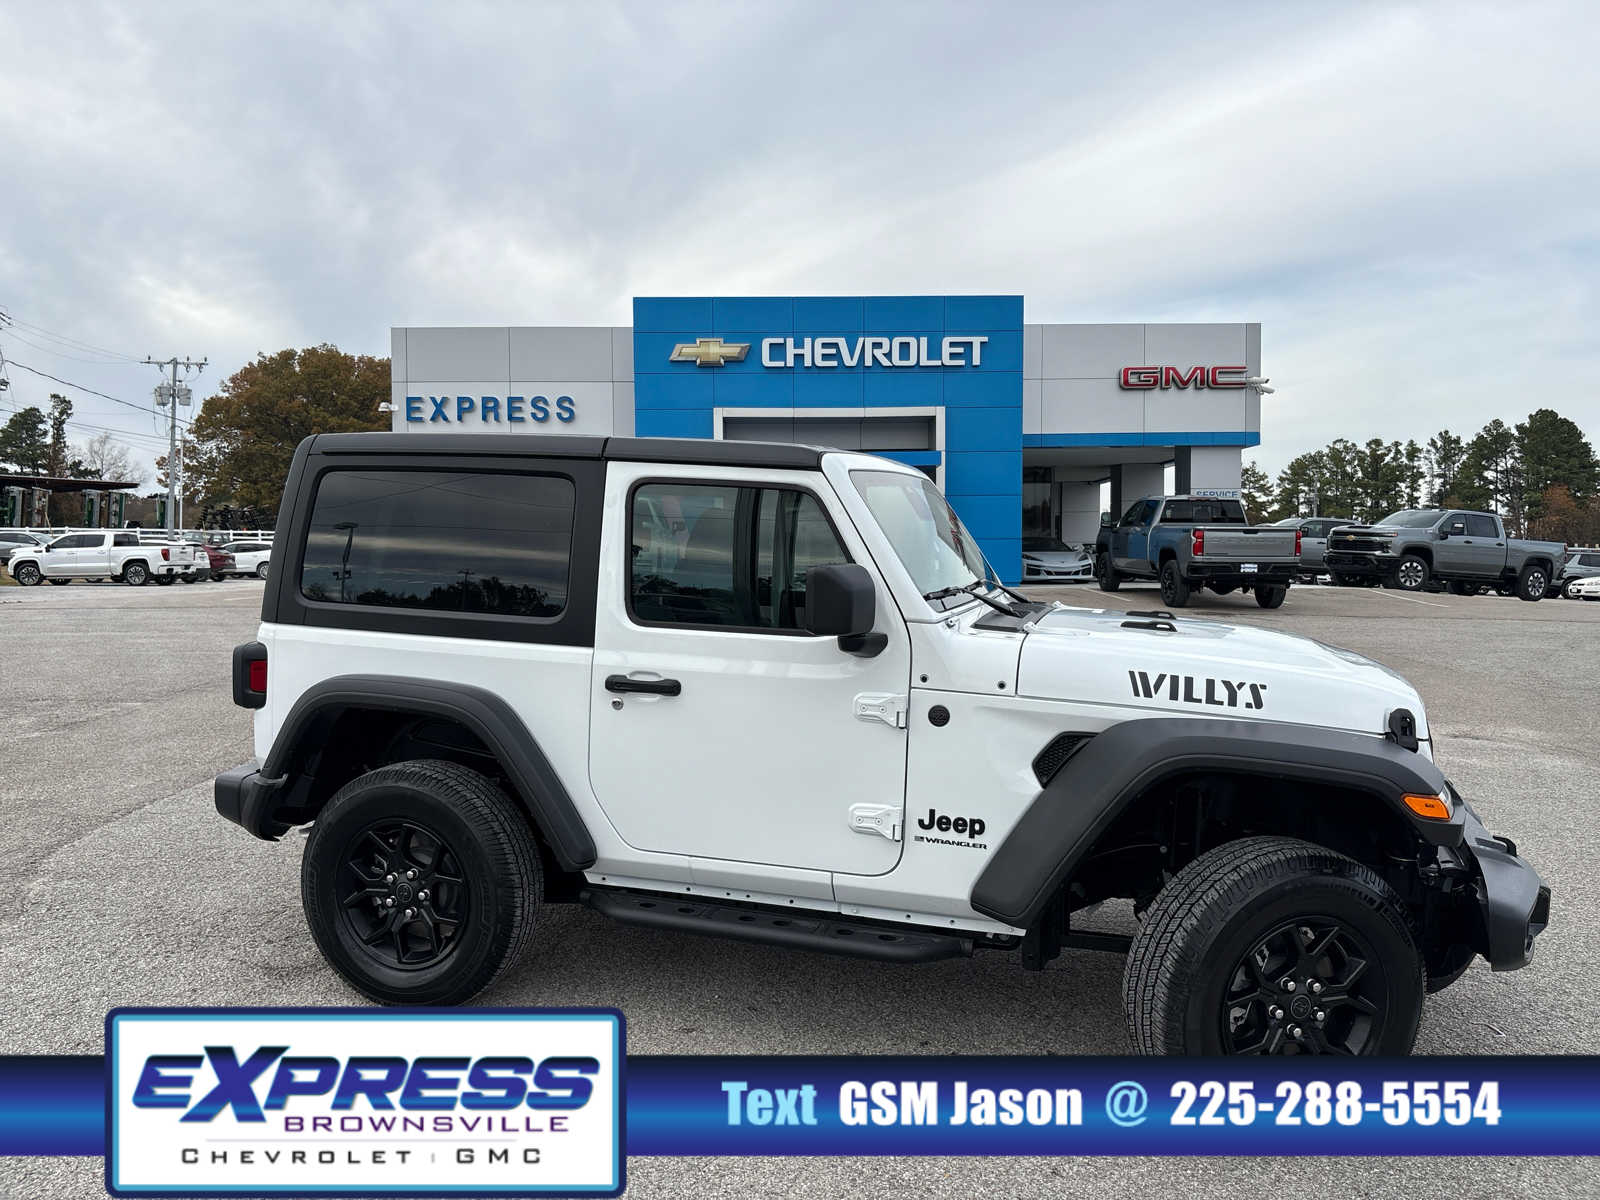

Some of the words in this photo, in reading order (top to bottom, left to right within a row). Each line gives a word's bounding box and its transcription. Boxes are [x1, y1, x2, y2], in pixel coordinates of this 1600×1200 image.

[761, 336, 988, 368] CHEVROLET
[1120, 365, 1248, 390] GMC
[405, 395, 577, 424] EXPRESS
[1128, 670, 1267, 710] WILLYS
[917, 808, 986, 839] Jeep
[925, 836, 988, 850] WRANGLER
